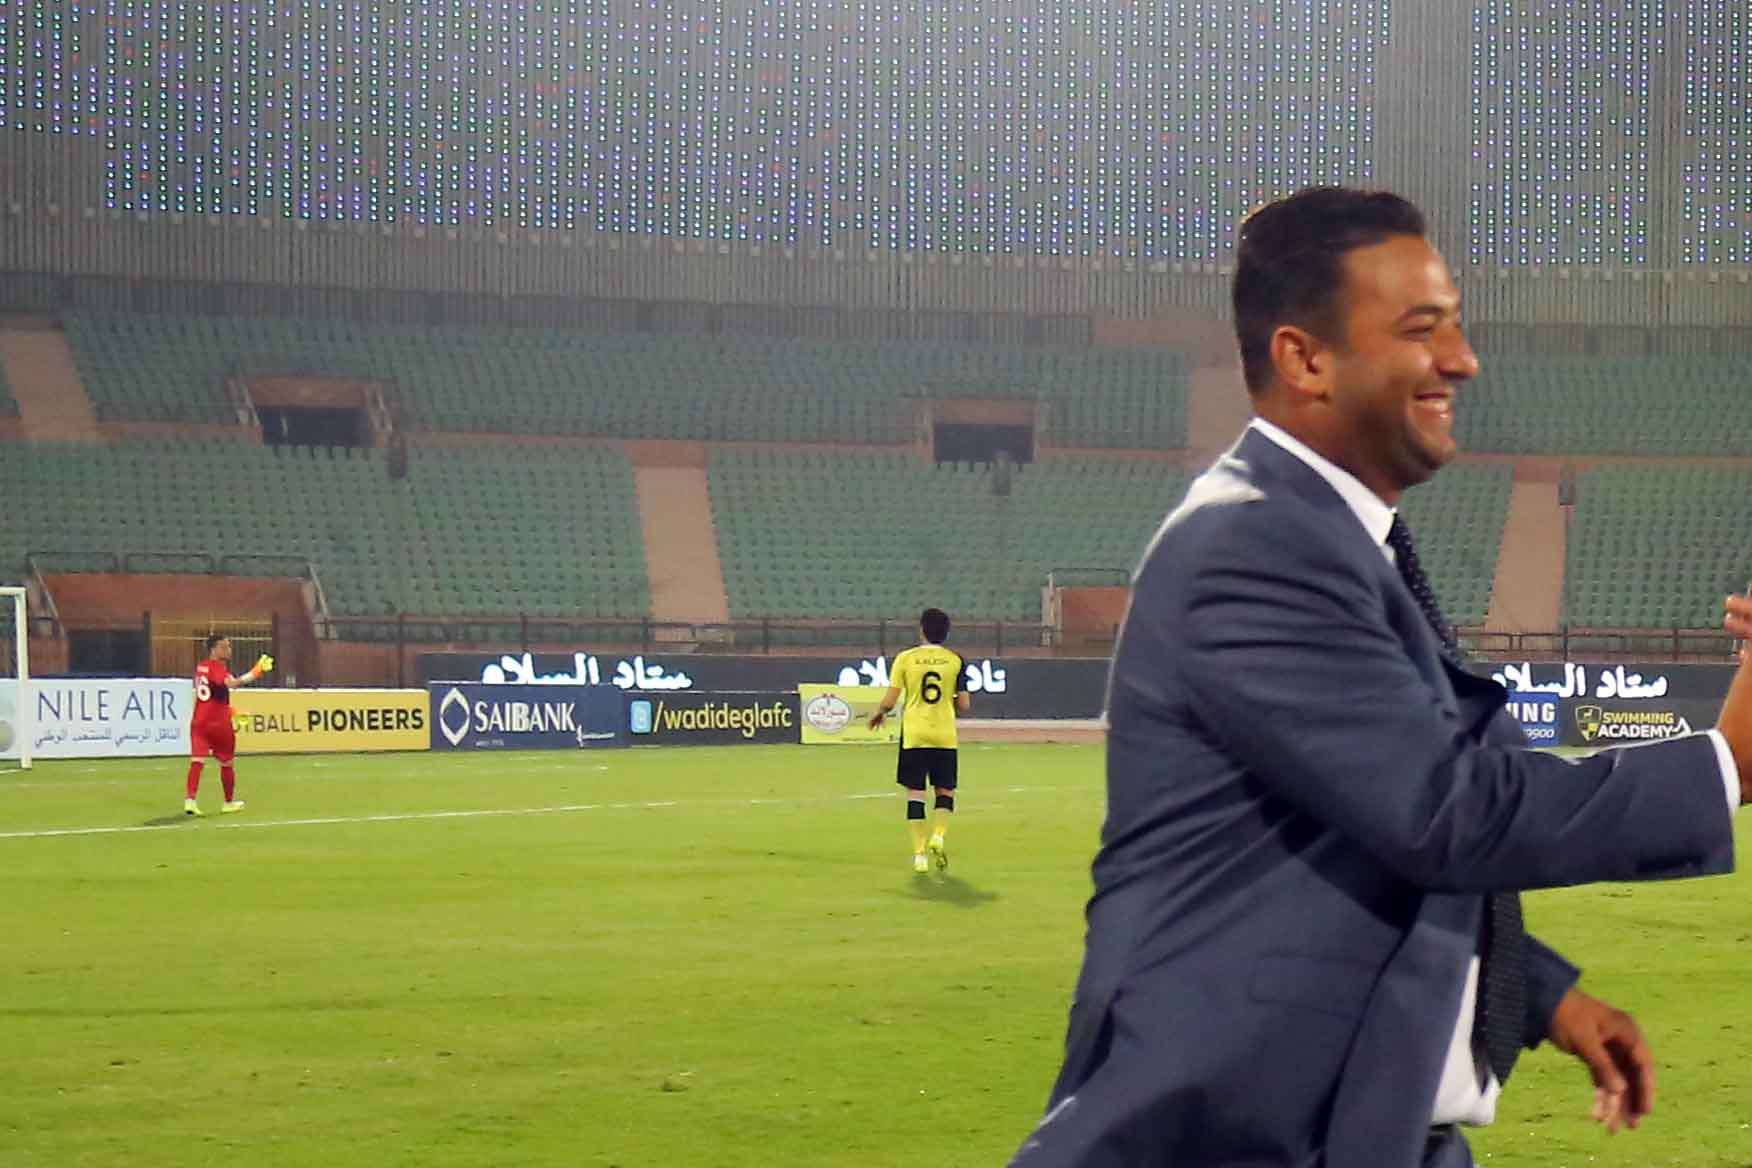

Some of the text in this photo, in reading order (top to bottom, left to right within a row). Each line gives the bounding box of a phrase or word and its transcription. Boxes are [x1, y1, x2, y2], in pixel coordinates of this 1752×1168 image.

[612, 655, 693, 690] ستاد
[920, 671, 943, 705] 6
[1595, 664, 1669, 698] ستاد
[37, 689, 177, 722] NILE AIR
[307, 708, 425, 732] PIONEERS
[1602, 711, 1675, 725] SWIMMING
[1598, 723, 1673, 738] ACADEMY
